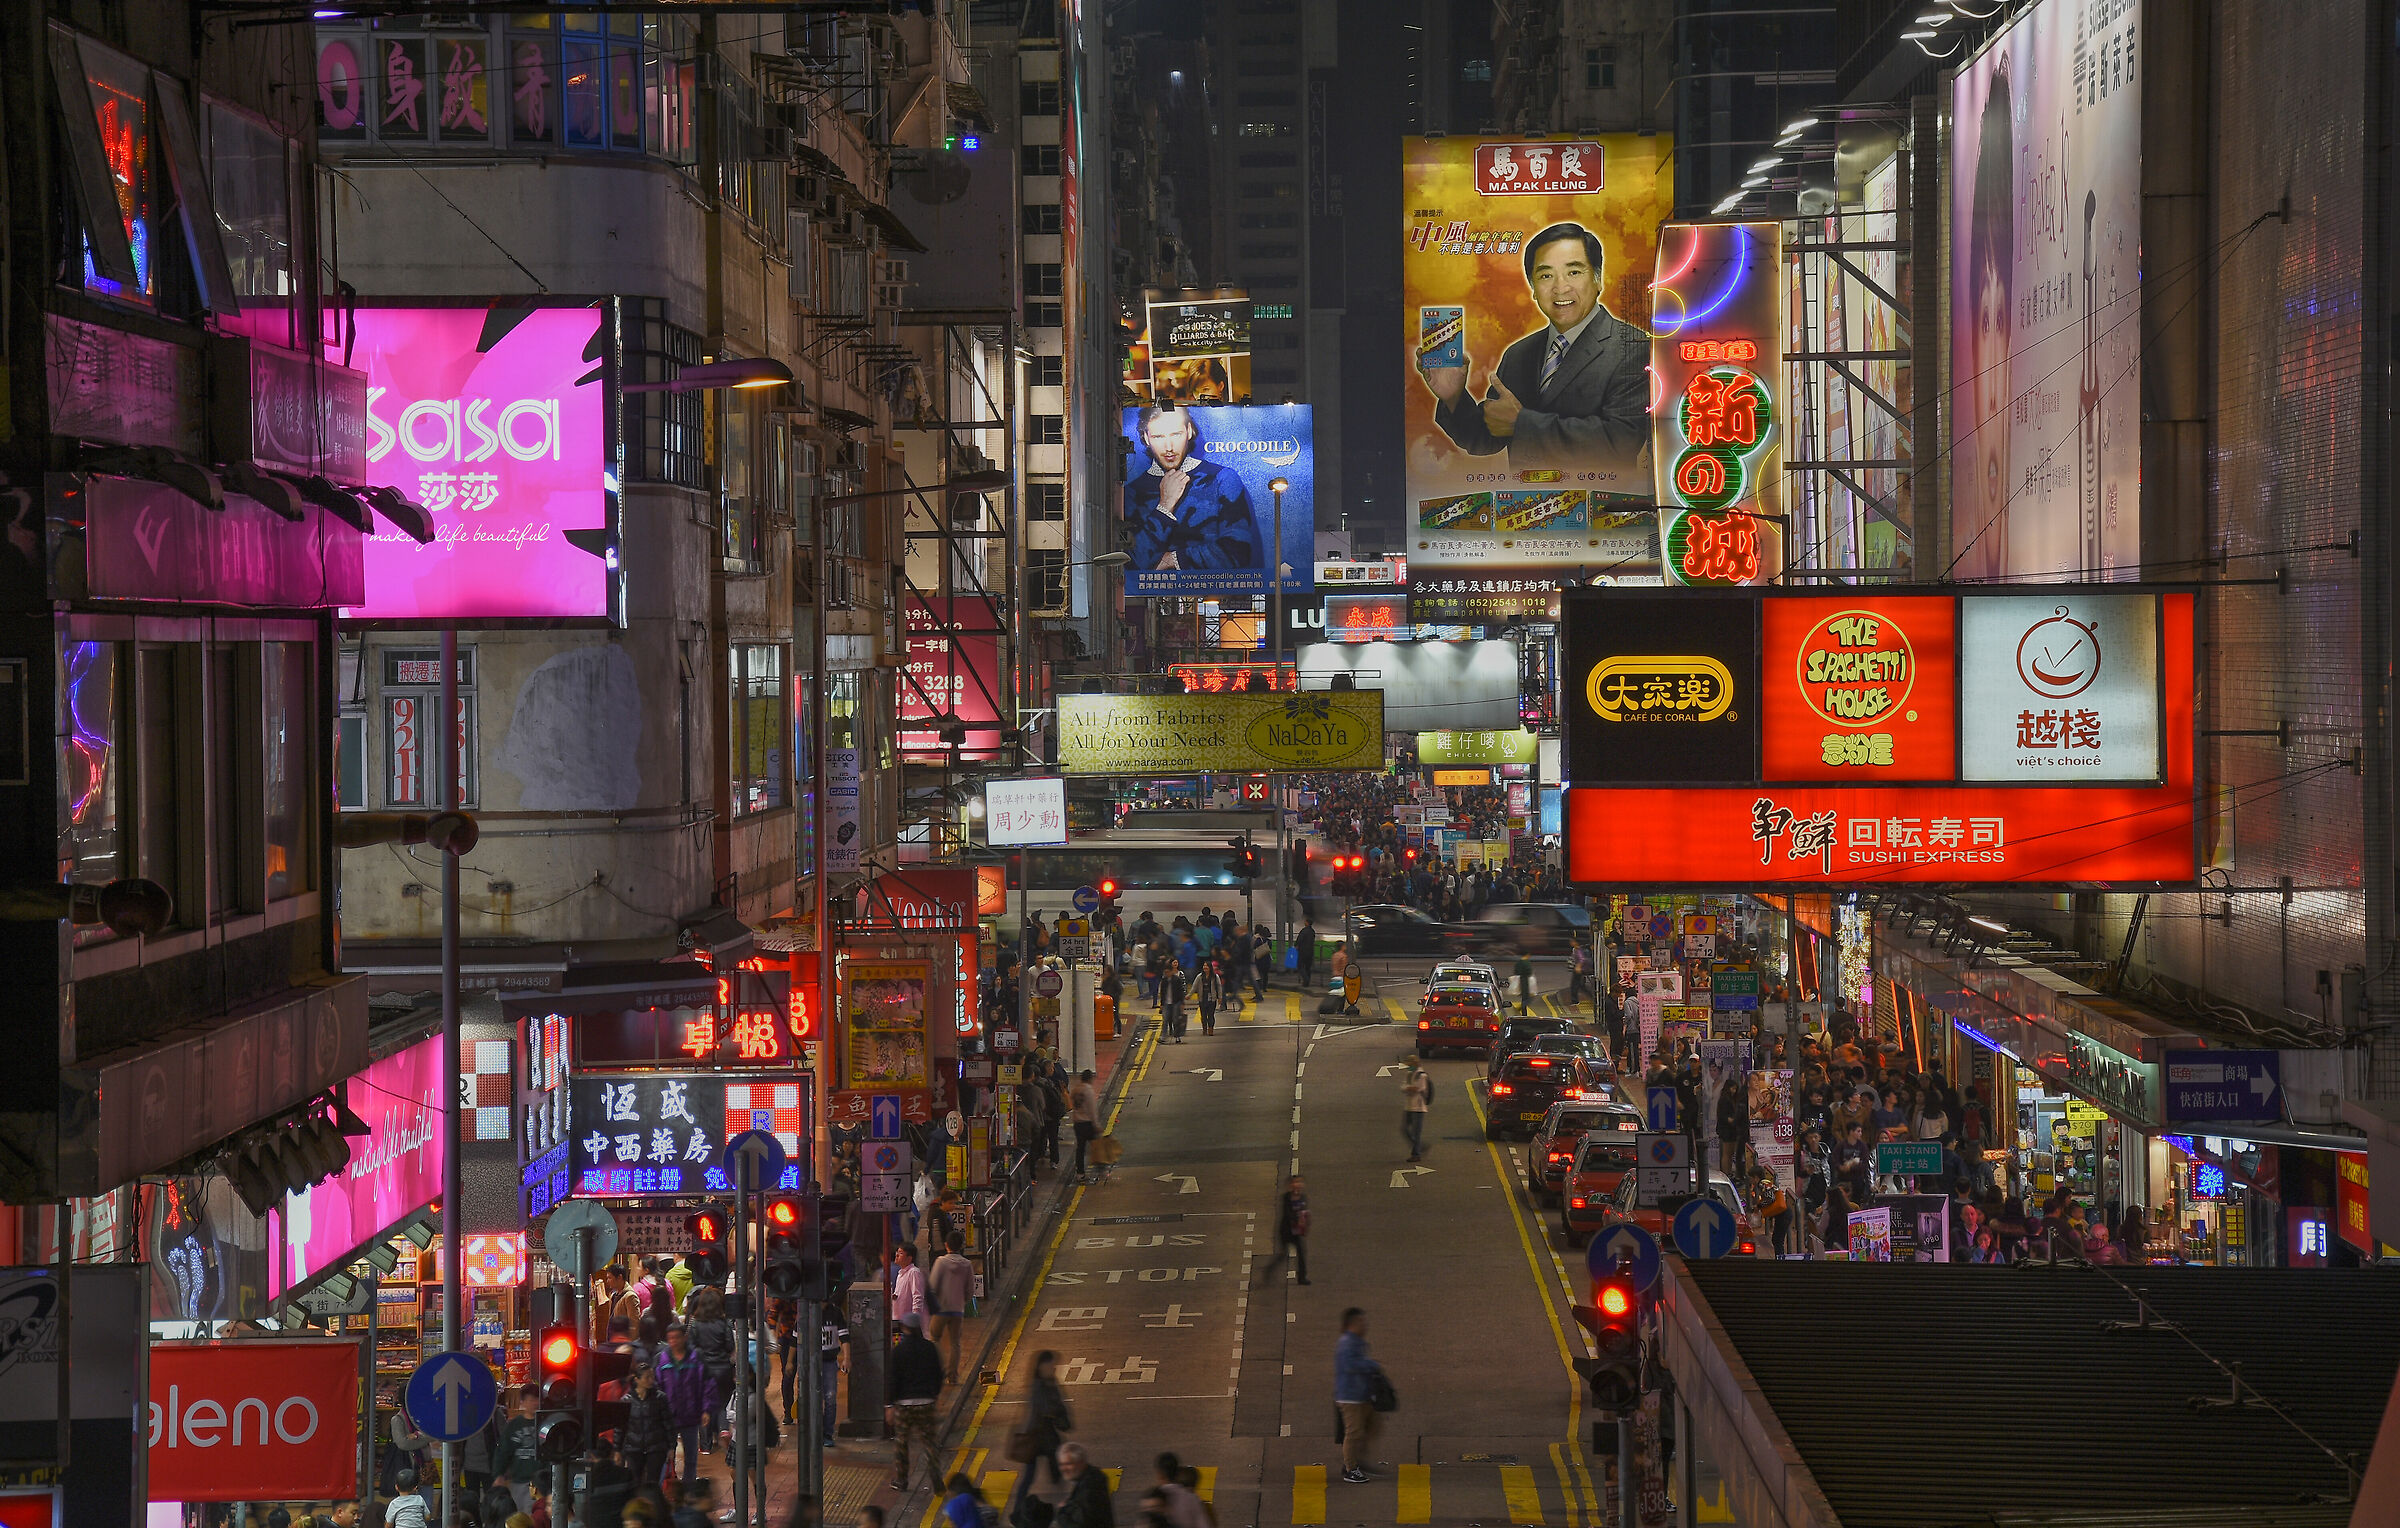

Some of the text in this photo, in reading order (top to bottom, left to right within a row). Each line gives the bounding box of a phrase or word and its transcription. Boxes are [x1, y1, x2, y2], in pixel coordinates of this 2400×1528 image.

[1489, 147, 1587, 181] 馬百良
[1488, 180, 1588, 192] MA PAK LEUNG
[1410, 220, 1470, 252] 中風
[1439, 242, 1520, 255] 不再是老人專利
[1170, 332, 1208, 345] BILLIARDS
[1217, 329, 1235, 341] BAR
[1204, 440, 1292, 453] CROCODILE
[1677, 374, 1759, 581] 新の城
[418, 472, 498, 511] 莎莎
[436, 523, 551, 551] life beautiful
[1522, 598, 1546, 607] 1018
[1346, 607, 1394, 628] 永成
[1828, 617, 1880, 647] THE
[1825, 686, 1892, 719] HOUSE
[1070, 707, 1226, 729] All from Fabrics
[1623, 711, 1697, 723] CAFÉ DE CORAL
[1268, 723, 1349, 746] NaRaYa
[2016, 708, 2102, 750] 越棧
[1070, 731, 1226, 751] All for Your Needs
[1821, 733, 1894, 766] 意粉屋
[1106, 756, 1194, 768] www.naraya.com
[1848, 816, 2005, 849] 回転寿司
[1848, 850, 2005, 863] SUSHI EXPRESS
[1066, 946, 1083, 956] 全日
[1703, 949, 1713, 957] 12
[2225, 1065, 2248, 1081] 商場
[601, 1081, 695, 1124] 恆盛
[2180, 1091, 2239, 1108] 快富街入口
[400, 1088, 436, 1174] beautiful
[1775, 1124, 1793, 1138] $138
[582, 1128, 713, 1165] 中西藥房
[1882, 1146, 1938, 1155] TAXI STAND
[1892, 1159, 1928, 1169] 的士站
[893, 1178, 901, 1189] 7
[1670, 1172, 1679, 1183] 7
[894, 1197, 908, 1208] 12
[1890, 1211, 1902, 1219] HE
[1074, 1234, 1207, 1250] BUS
[1045, 1267, 1222, 1286] STOP
[1035, 1304, 1203, 1332] 巴士
